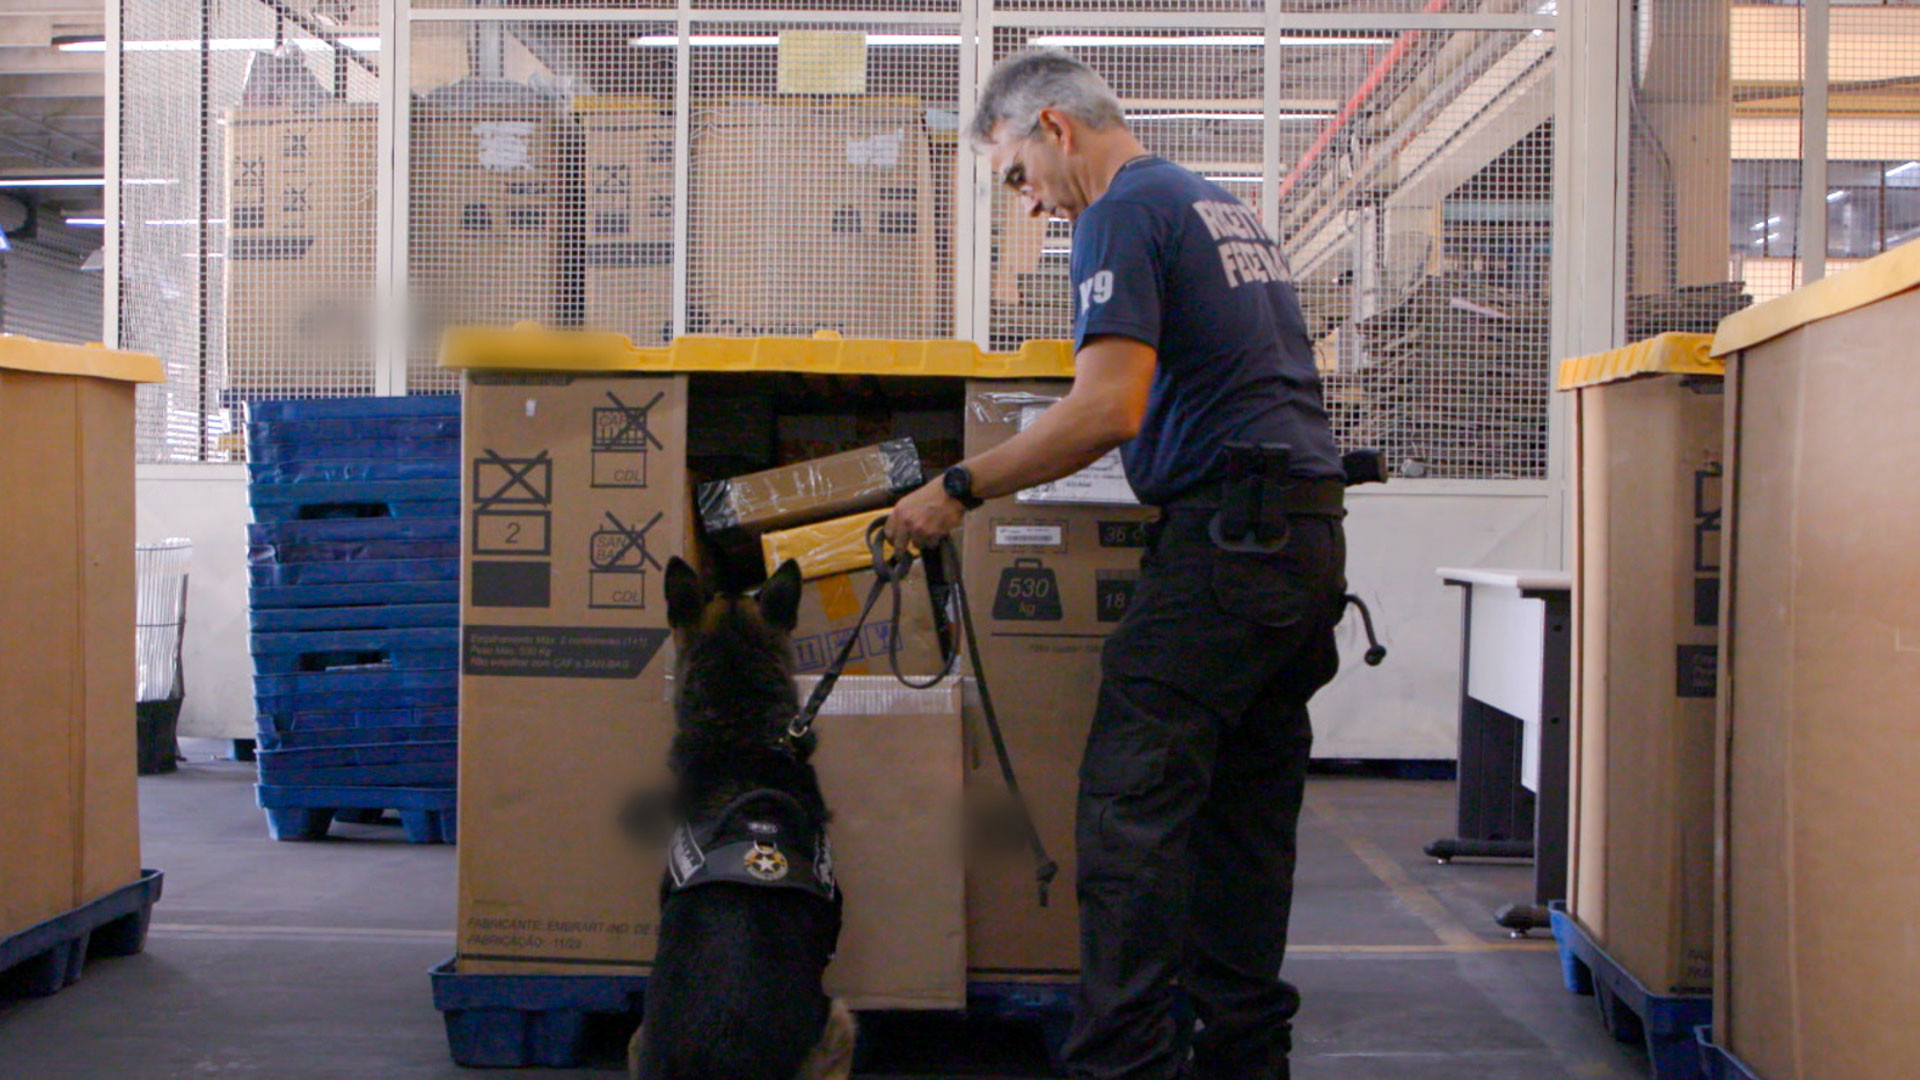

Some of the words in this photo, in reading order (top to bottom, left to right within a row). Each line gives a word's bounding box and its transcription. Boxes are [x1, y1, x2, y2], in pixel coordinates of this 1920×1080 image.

[505, 522, 521, 543] 2
[1007, 577, 1050, 598] 530
[1018, 602, 1036, 617] kg
[1104, 592, 1126, 610] 18
